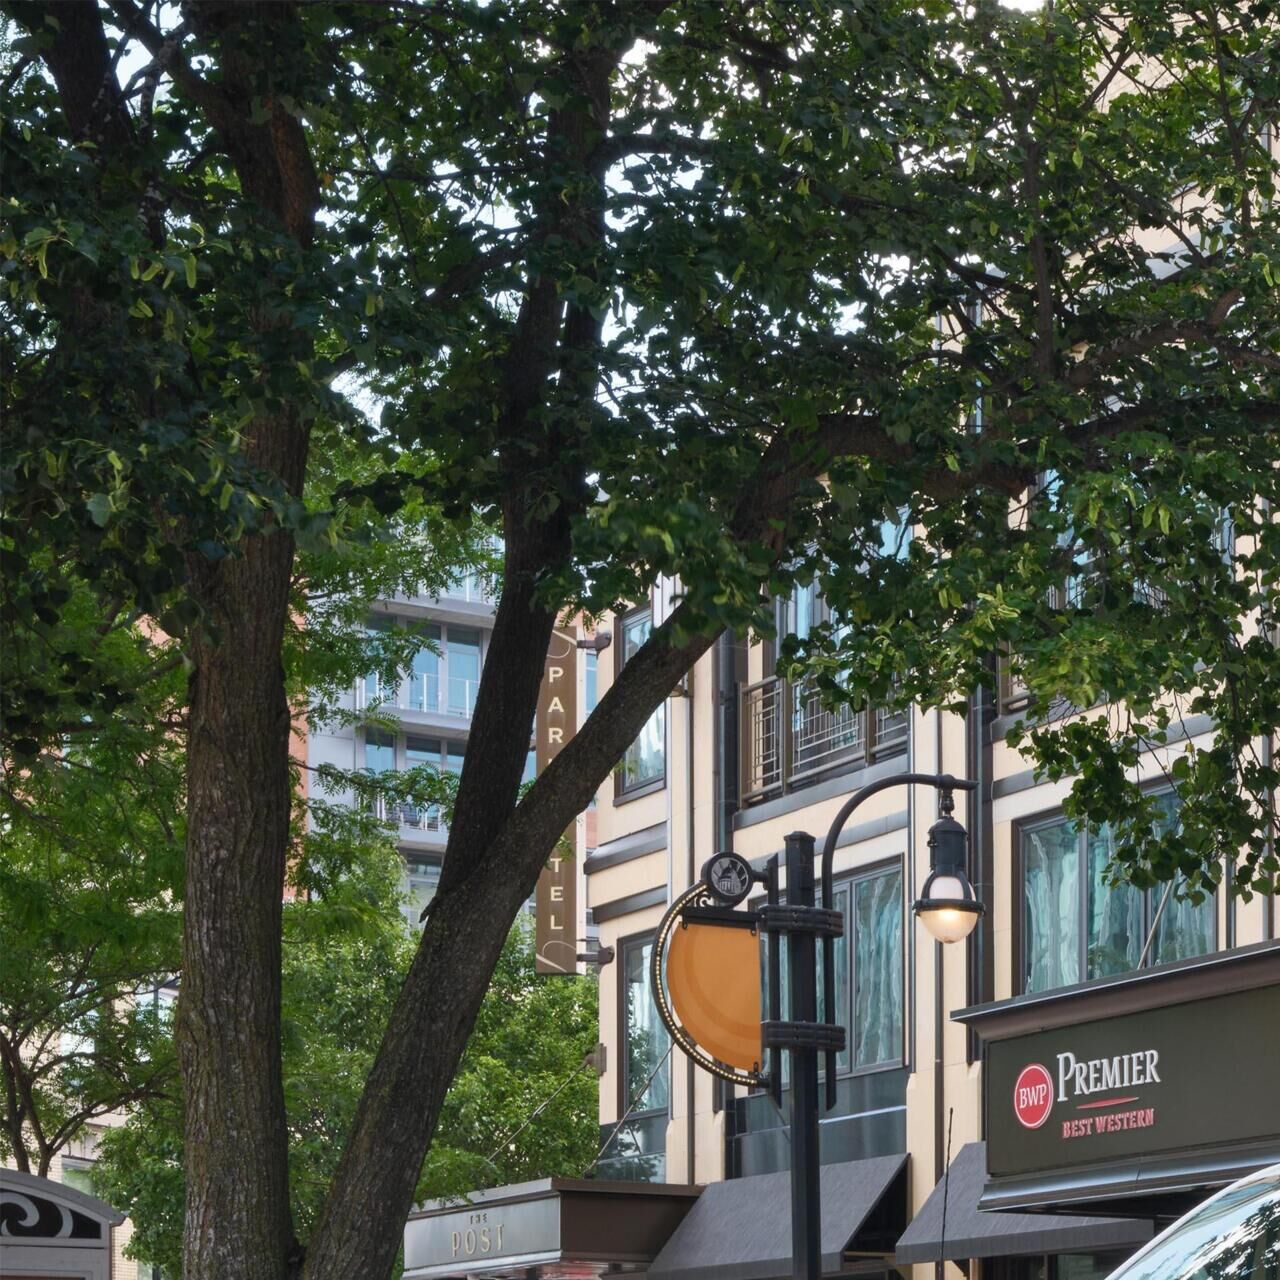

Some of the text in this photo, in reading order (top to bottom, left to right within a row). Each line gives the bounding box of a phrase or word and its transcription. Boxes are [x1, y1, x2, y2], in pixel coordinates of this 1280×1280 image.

[548, 666, 565, 765] PAR
[549, 857, 565, 931] TEL
[1056, 1049, 1161, 1102] PREMIER
[1019, 1084, 1047, 1109] BWP
[1062, 1108, 1155, 1139] BEST WESTERN
[470, 1213, 488, 1225] THE
[452, 1224, 505, 1257] POST
